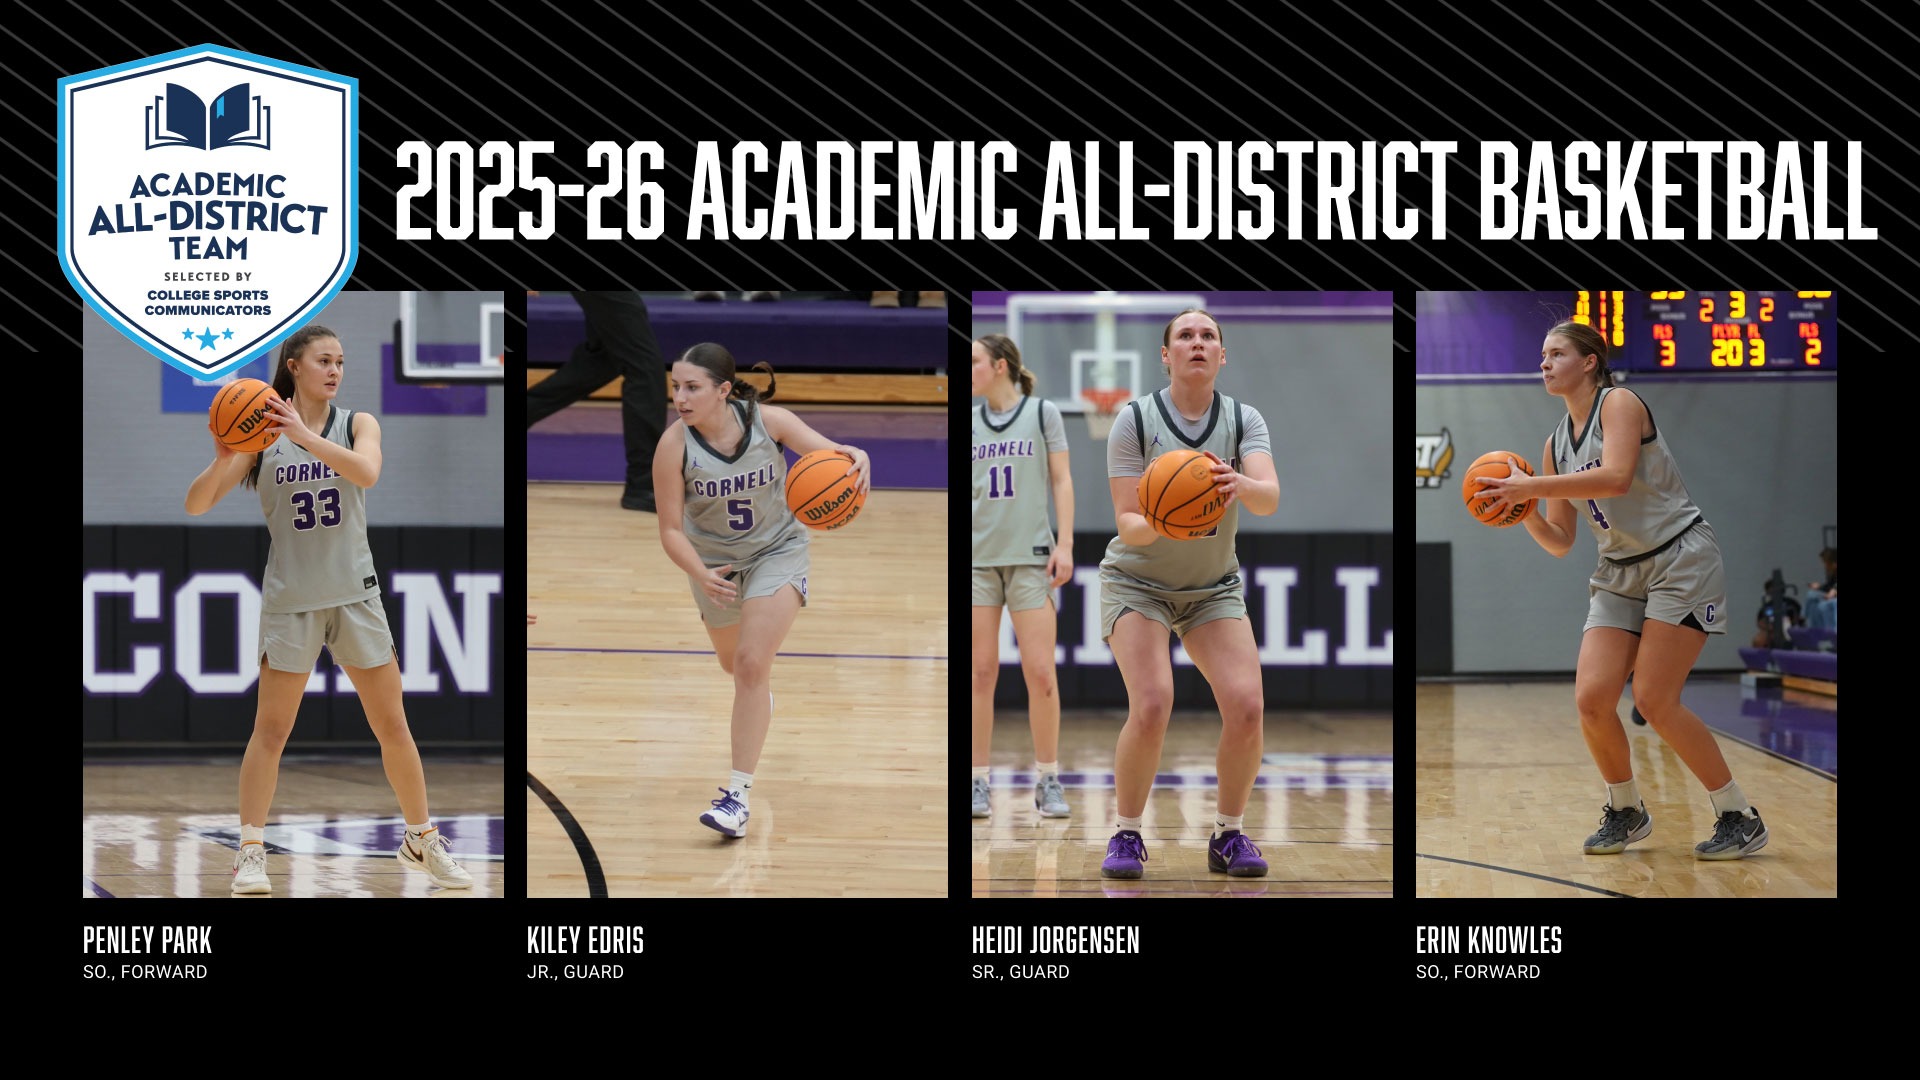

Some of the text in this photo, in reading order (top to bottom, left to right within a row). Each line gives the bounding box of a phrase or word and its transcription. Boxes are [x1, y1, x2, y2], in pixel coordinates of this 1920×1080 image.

[1699, 298, 1715, 322] 2
[1729, 291, 1746, 318] 3
[1759, 297, 1775, 322] 2
[1660, 339, 1677, 367] 3
[1711, 338, 1766, 367] 20 3
[1804, 338, 1822, 366] 2
[236, 402, 274, 435] Wilso
[275, 459, 342, 486] CORNE
[693, 463, 776, 499] CORNELL
[988, 464, 1015, 500] 11
[290, 486, 342, 532] 33
[726, 498, 756, 532] 5
[804, 486, 855, 522] Wilson
[1704, 602, 1717, 625] C
